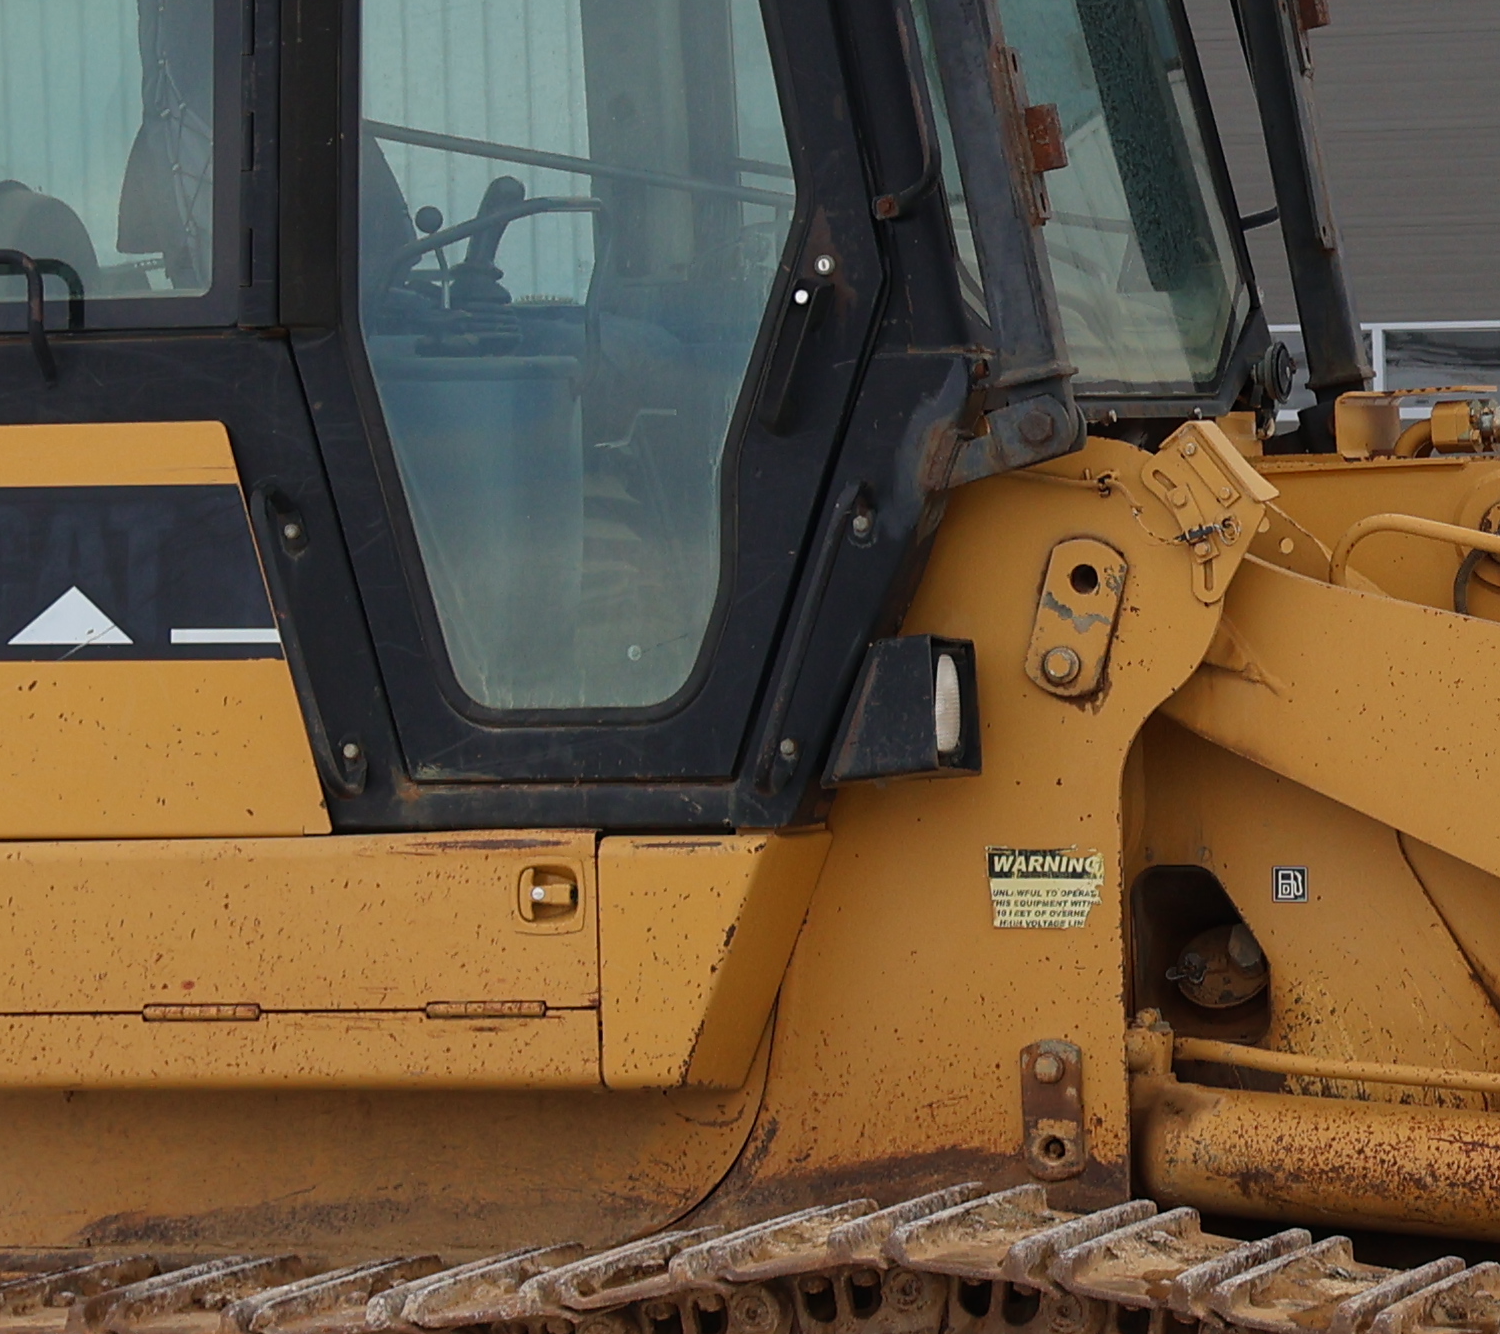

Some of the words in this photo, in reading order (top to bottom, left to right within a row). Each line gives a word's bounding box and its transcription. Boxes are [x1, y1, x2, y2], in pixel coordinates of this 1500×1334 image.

[993, 855, 1101, 873] WARNING
[1046, 889, 1057, 897] TO
[1014, 899, 1068, 907] EQUIPMENT
[1034, 909, 1047, 917] OF
[1025, 919, 1067, 927] VOLTAGE
